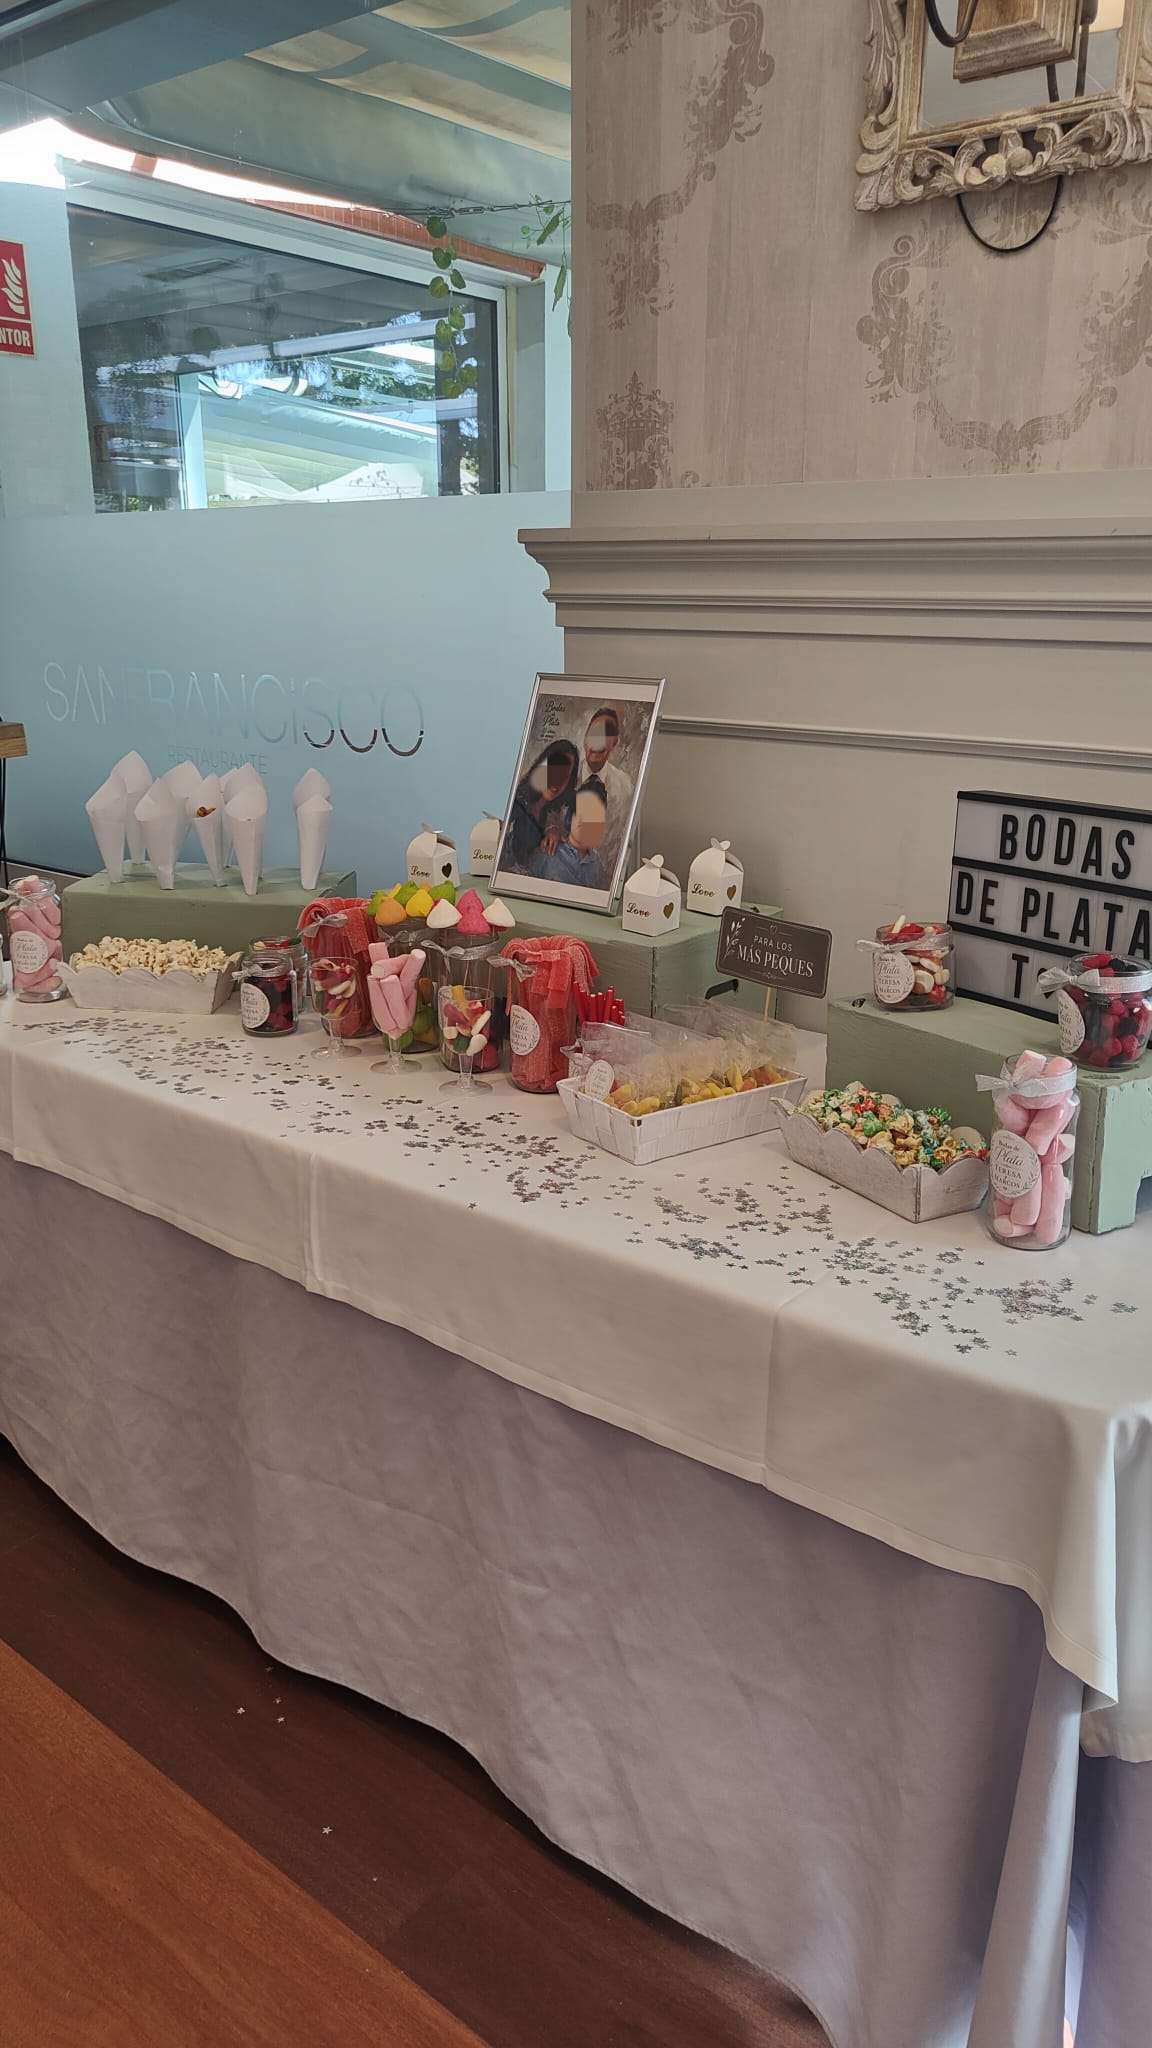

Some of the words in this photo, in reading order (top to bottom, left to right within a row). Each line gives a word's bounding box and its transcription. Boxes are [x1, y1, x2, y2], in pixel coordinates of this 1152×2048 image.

[472, 849, 495, 861] Love
[999, 813, 1135, 880] BODAS
[410, 865, 431, 879] Love
[691, 882, 716, 898] Love
[626, 901, 652, 918] Love
[955, 871, 999, 926] DE
[1020, 887, 1151, 961] PLATA
[753, 935, 774, 948] PARA
[776, 942, 793, 953] LOS
[737, 944, 761, 965] MÁS
[763, 951, 814, 978] PEQUES
[994, 1147, 1023, 1166] Plata
[995, 1163, 1022, 1180] TERESA
